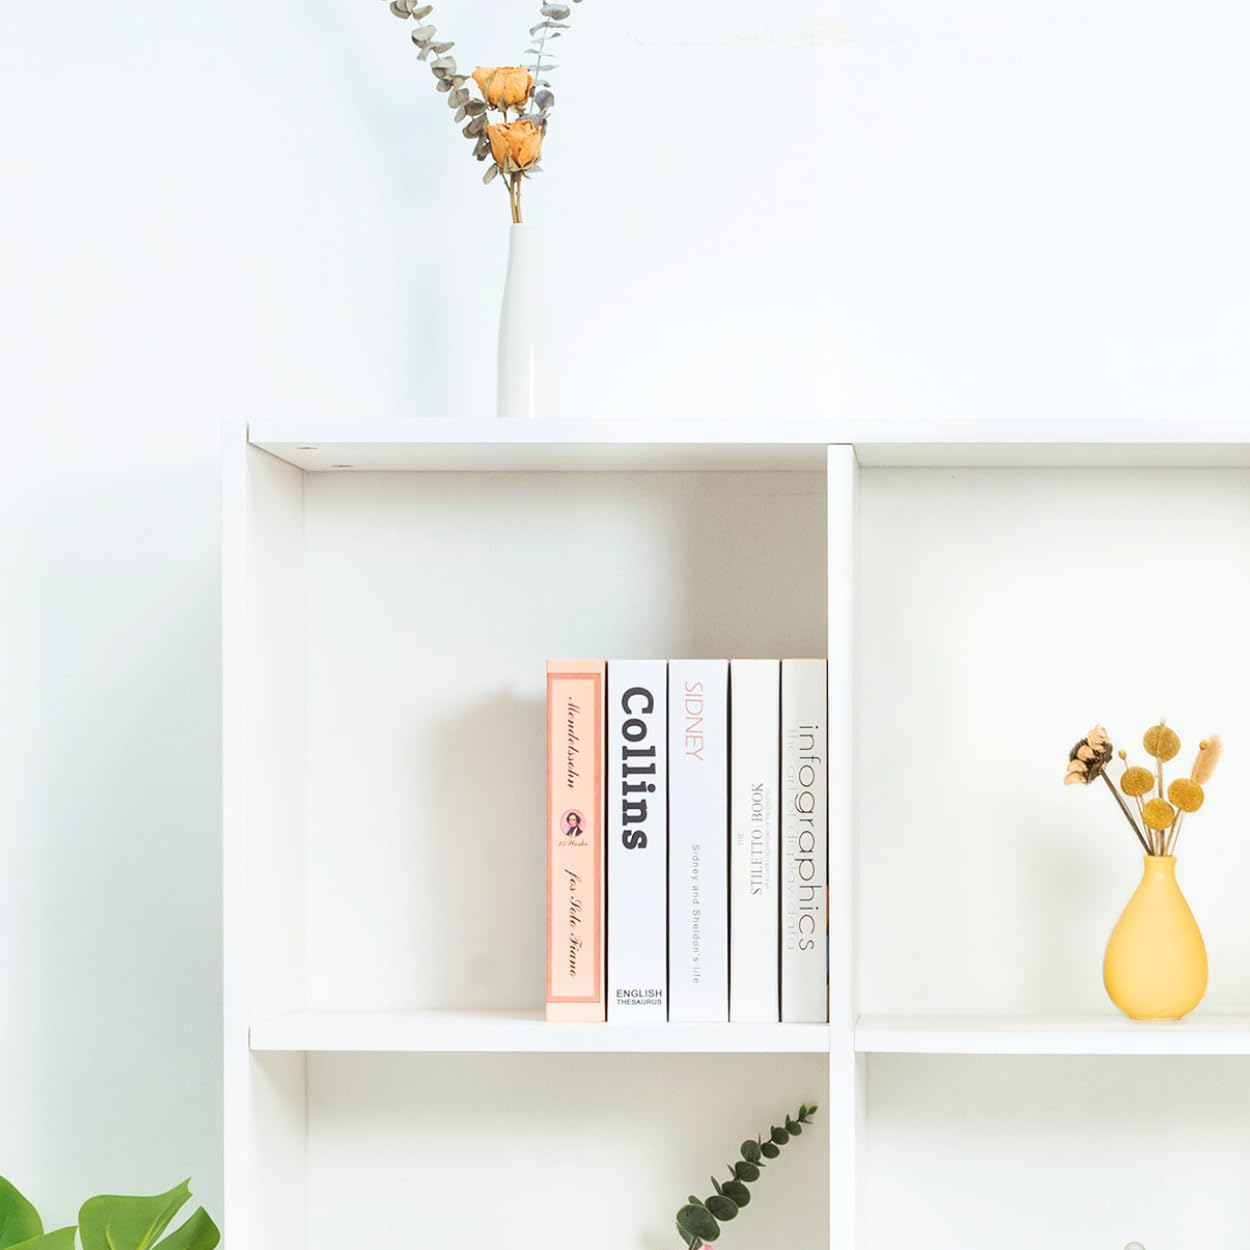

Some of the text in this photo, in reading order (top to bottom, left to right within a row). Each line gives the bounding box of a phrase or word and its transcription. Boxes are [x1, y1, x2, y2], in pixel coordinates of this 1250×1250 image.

[621, 687, 656, 850] Collins
[685, 681, 703, 760] SIDNEY
[751, 784, 763, 895] STILETTO BOOK
[795, 725, 821, 951] infographics
[691, 844, 702, 984] Sidney and Sheldon's life
[617, 989, 662, 997] ENGLISH
